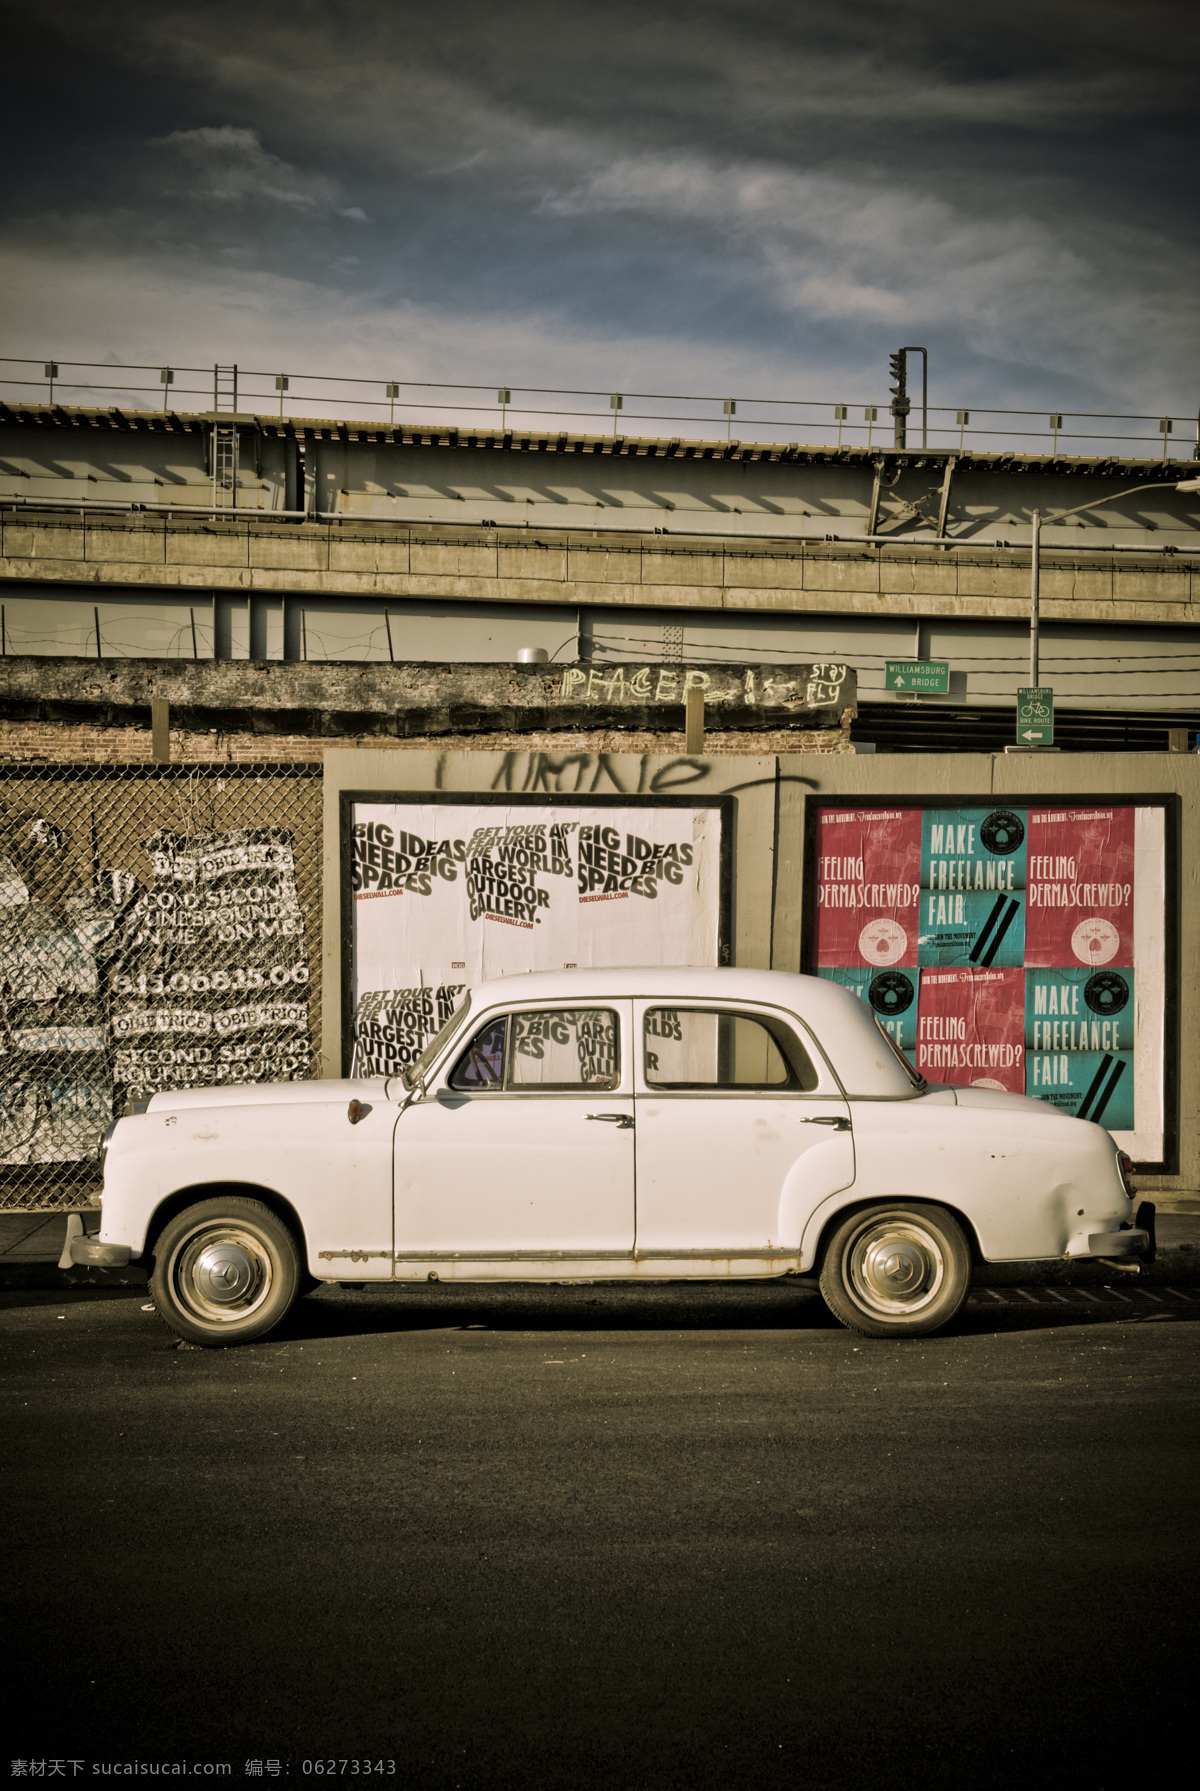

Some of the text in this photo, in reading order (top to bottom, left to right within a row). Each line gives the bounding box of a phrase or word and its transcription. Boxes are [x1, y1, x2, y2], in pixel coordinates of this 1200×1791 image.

[888, 665, 946, 675] WILLIAMSBURG
[911, 678, 940, 687] BRIDGE
[352, 822, 466, 863] BIG IDEAS
[472, 822, 580, 839] GET YOUR ART
[930, 824, 975, 854] MAKE
[465, 846, 493, 859] THE
[467, 834, 569, 859] FEATURED IN
[578, 824, 693, 866] BIG IDEAS
[352, 838, 457, 882] NEED BIG
[465, 857, 537, 887] LARGEST
[578, 841, 684, 885] NEED BIG
[818, 856, 863, 880] FEELING
[1030, 856, 1075, 880] FEELING
[352, 860, 432, 896] SPACES
[578, 862, 658, 899] SPACES
[929, 860, 1015, 890] FREELANCE
[353, 889, 403, 900] DIESELWALL.COM
[466, 874, 551, 908] OUTDOOR
[579, 892, 629, 903] DIESELWALL.COM
[817, 884, 920, 907] PERMASCREWED?
[1029, 883, 1131, 907] PERMASCREWED?
[469, 893, 542, 924] GALLERY.
[928, 894, 968, 926] FAIR.
[485, 913, 534, 930] DIESELWALL.COM
[360, 984, 466, 1002] GET YOUR ART
[1034, 985, 1079, 1015] MAKE
[220, 1007, 309, 1028] OBIE TRICE
[356, 998, 454, 1019] FEATURED IN
[161, 1015, 210, 1028] TRICE
[527, 1020, 570, 1045] BIG
[920, 1016, 965, 1040] FEELING
[1034, 1021, 1119, 1050] FREELANCE
[115, 1039, 309, 1065] SECOND SECOND
[919, 1044, 1022, 1067] PERMASCREWED?
[1033, 1055, 1073, 1086] FAIR.
